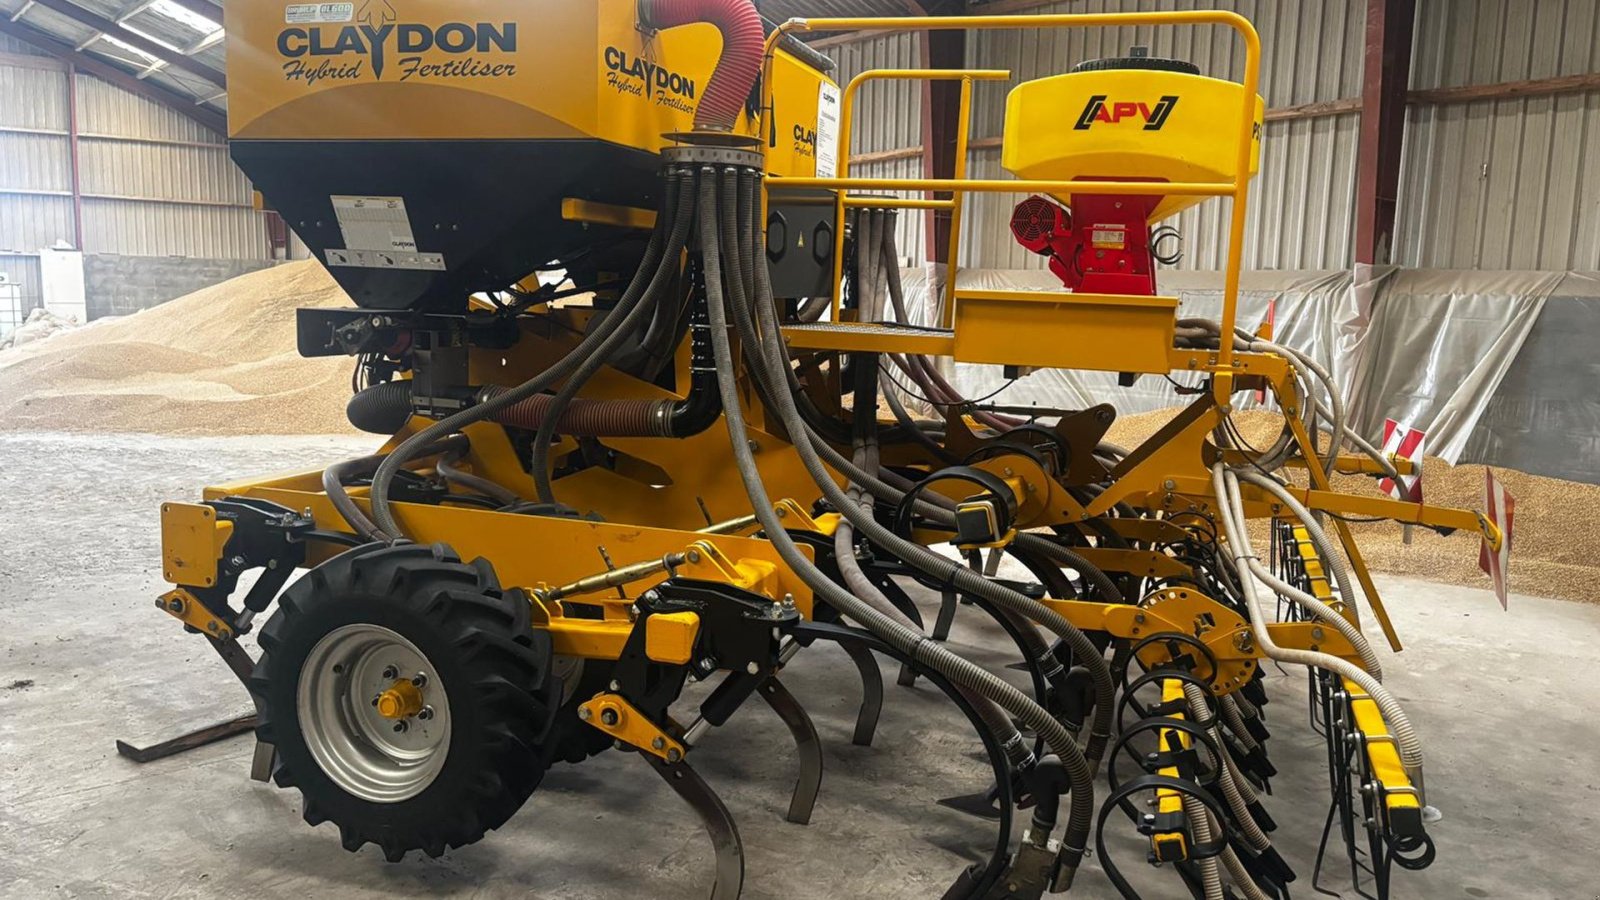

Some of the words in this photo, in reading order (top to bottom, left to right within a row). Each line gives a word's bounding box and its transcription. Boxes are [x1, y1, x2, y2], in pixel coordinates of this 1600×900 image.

[277, 22, 517, 80] CLAYDON
[282, 60, 361, 86] Hybrid
[398, 57, 517, 81] Fertiliser
[604, 46, 694, 100] CLAYDON
[606, 72, 643, 96] Hybrid
[656, 90, 694, 114] Fertiliser
[1084, 100, 1168, 125] APV
